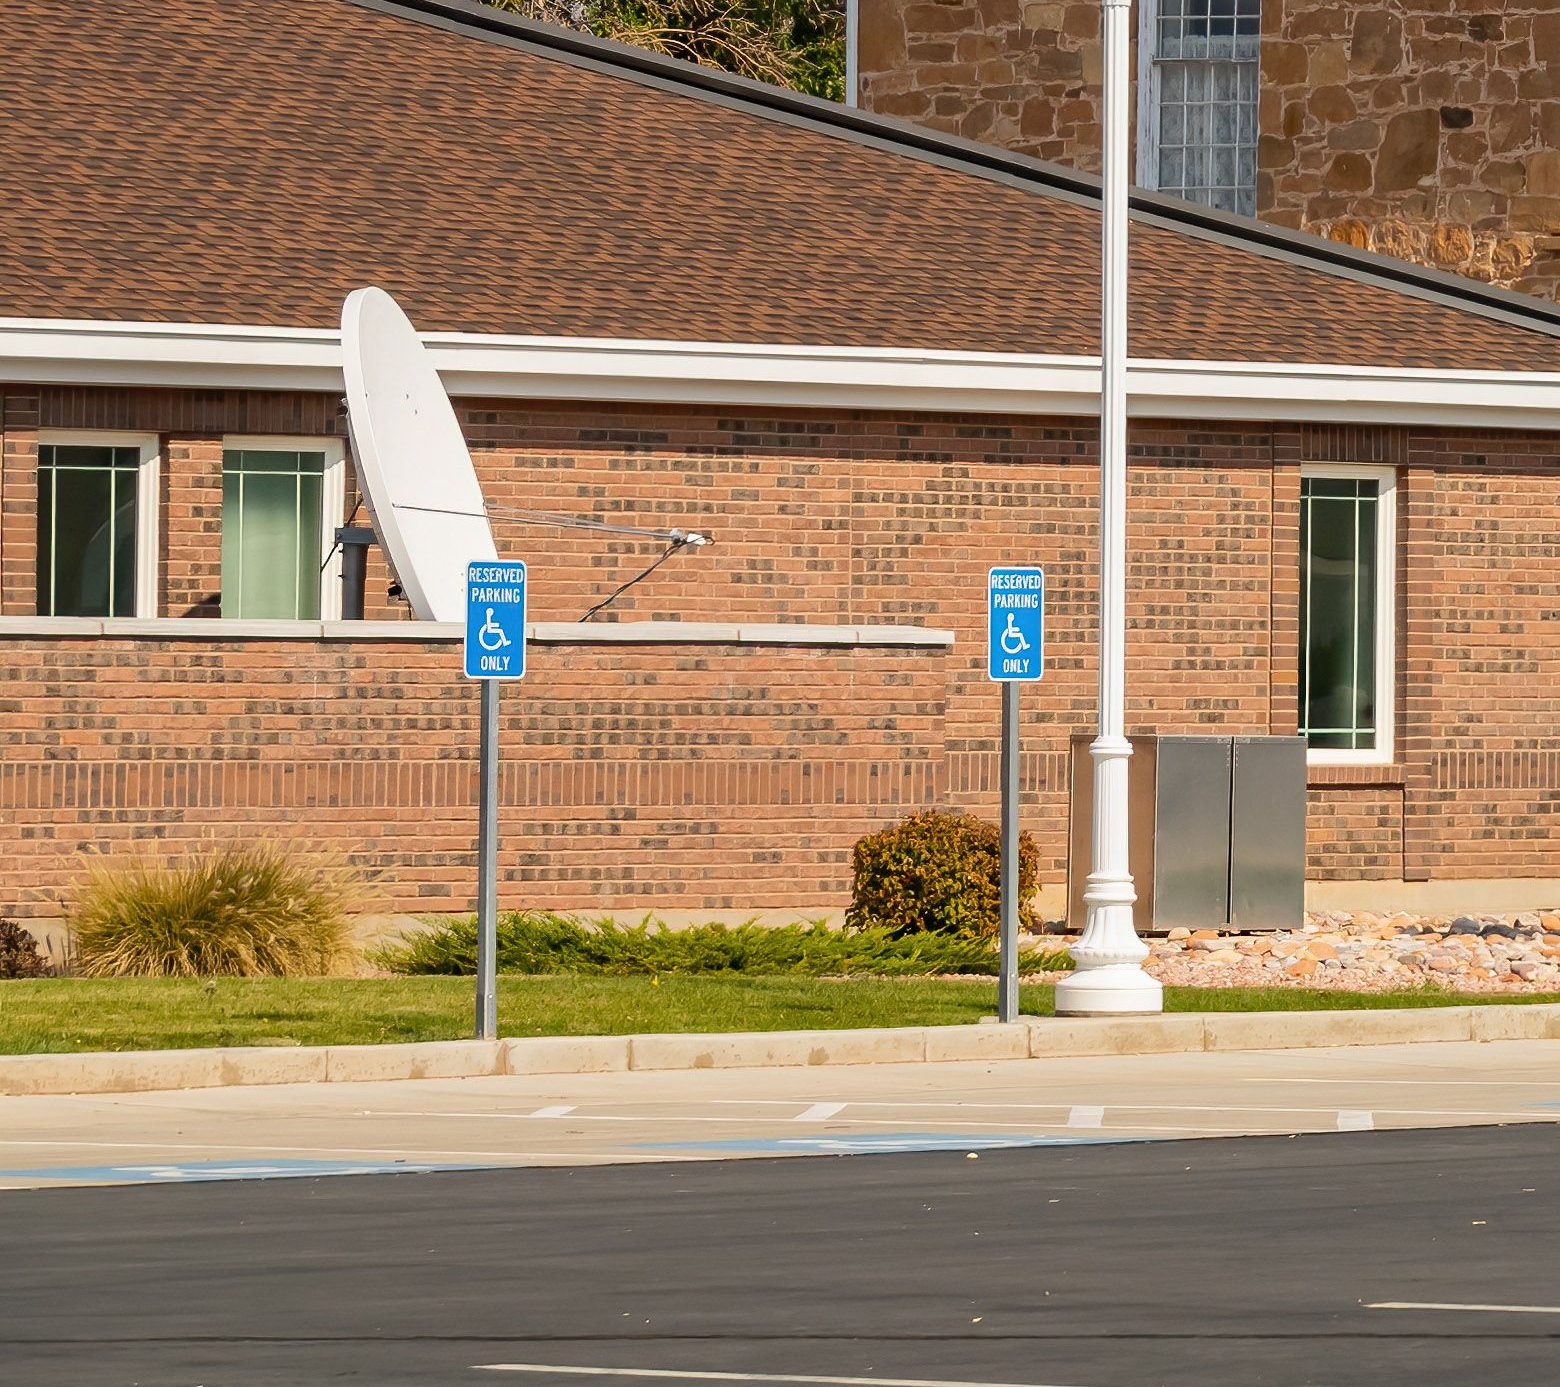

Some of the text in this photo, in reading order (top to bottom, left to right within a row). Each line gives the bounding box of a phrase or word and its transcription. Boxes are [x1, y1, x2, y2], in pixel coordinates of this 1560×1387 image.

[469, 567, 524, 583] RESERVED
[991, 574, 1041, 589] RESERVED
[471, 587, 521, 603] PARKING
[994, 593, 1039, 608] PARKING
[480, 655, 511, 671] ONLY
[1003, 658, 1030, 673] ONLY
